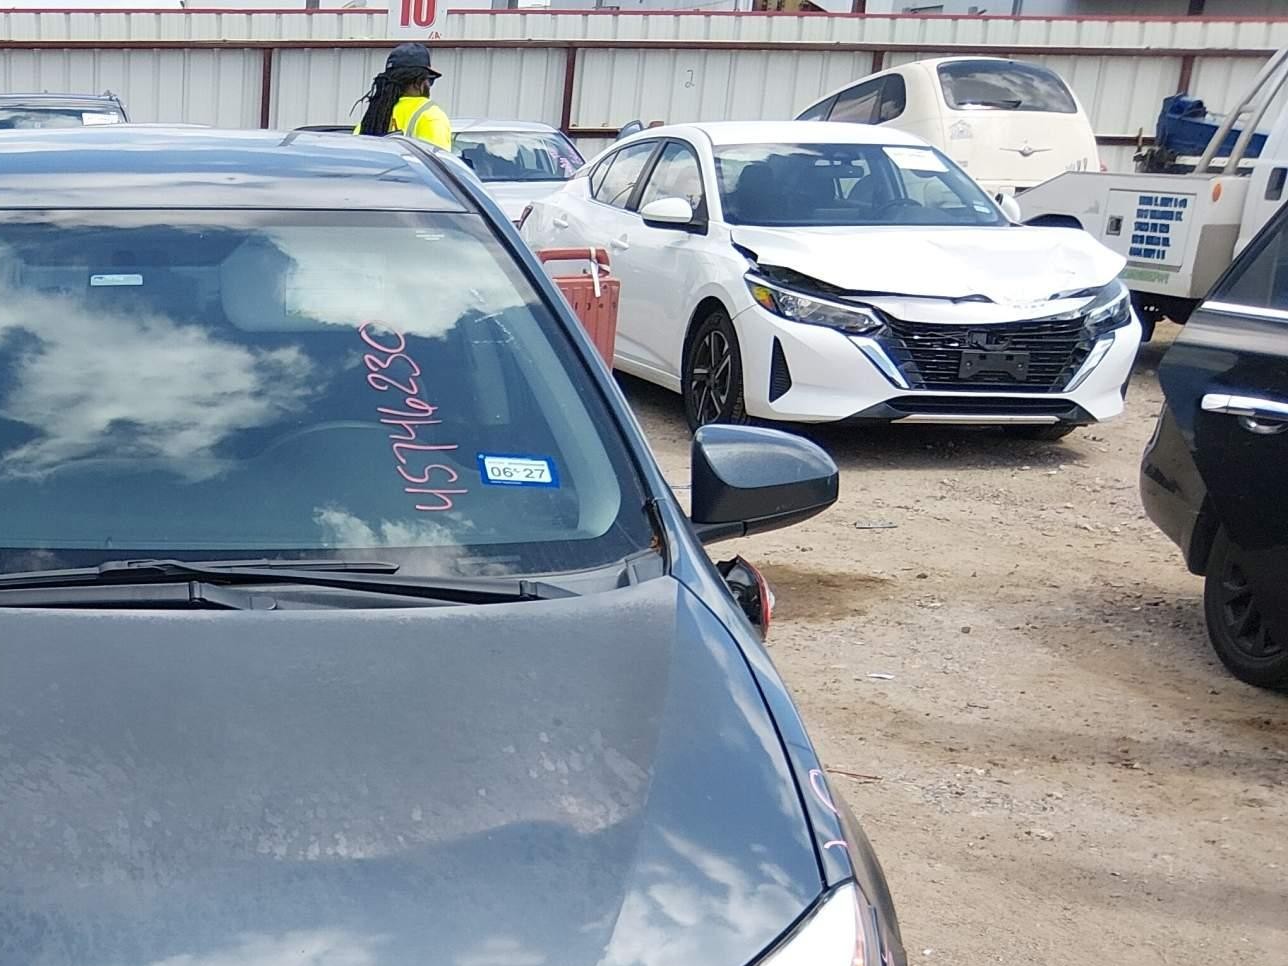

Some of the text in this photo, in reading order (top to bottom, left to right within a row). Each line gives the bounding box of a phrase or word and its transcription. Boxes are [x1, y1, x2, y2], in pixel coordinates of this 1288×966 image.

[359, 319, 467, 510] 45746230
[490, 466, 546, 479] 06 27
